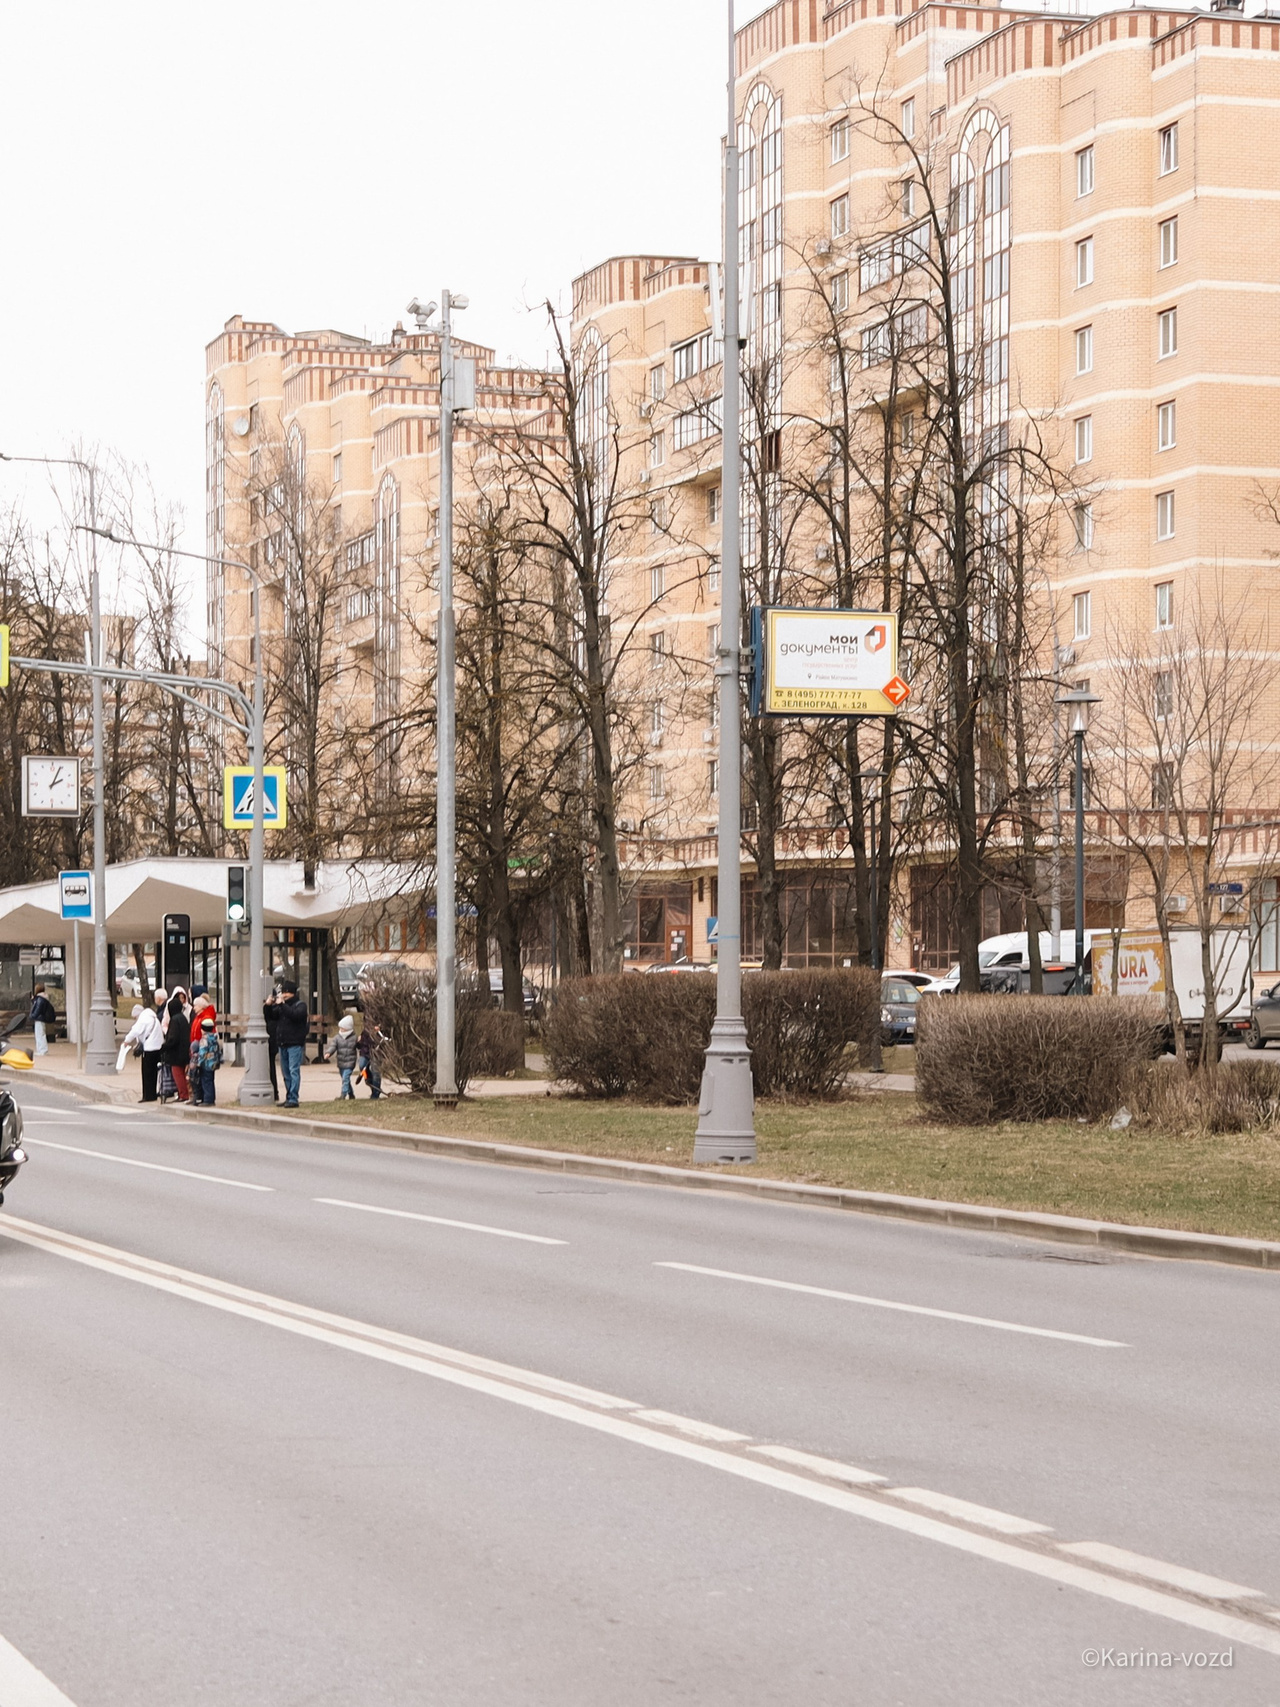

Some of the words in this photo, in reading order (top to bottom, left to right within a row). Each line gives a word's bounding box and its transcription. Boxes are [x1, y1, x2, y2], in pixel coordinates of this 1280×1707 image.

[830, 635, 858, 644] мои
[780, 643, 858, 656] документы
[794, 690, 817, 698] (495)
[819, 691, 862, 699] 777-77-77
[851, 701, 867, 709] 128
[1117, 955, 1148, 978] URA
